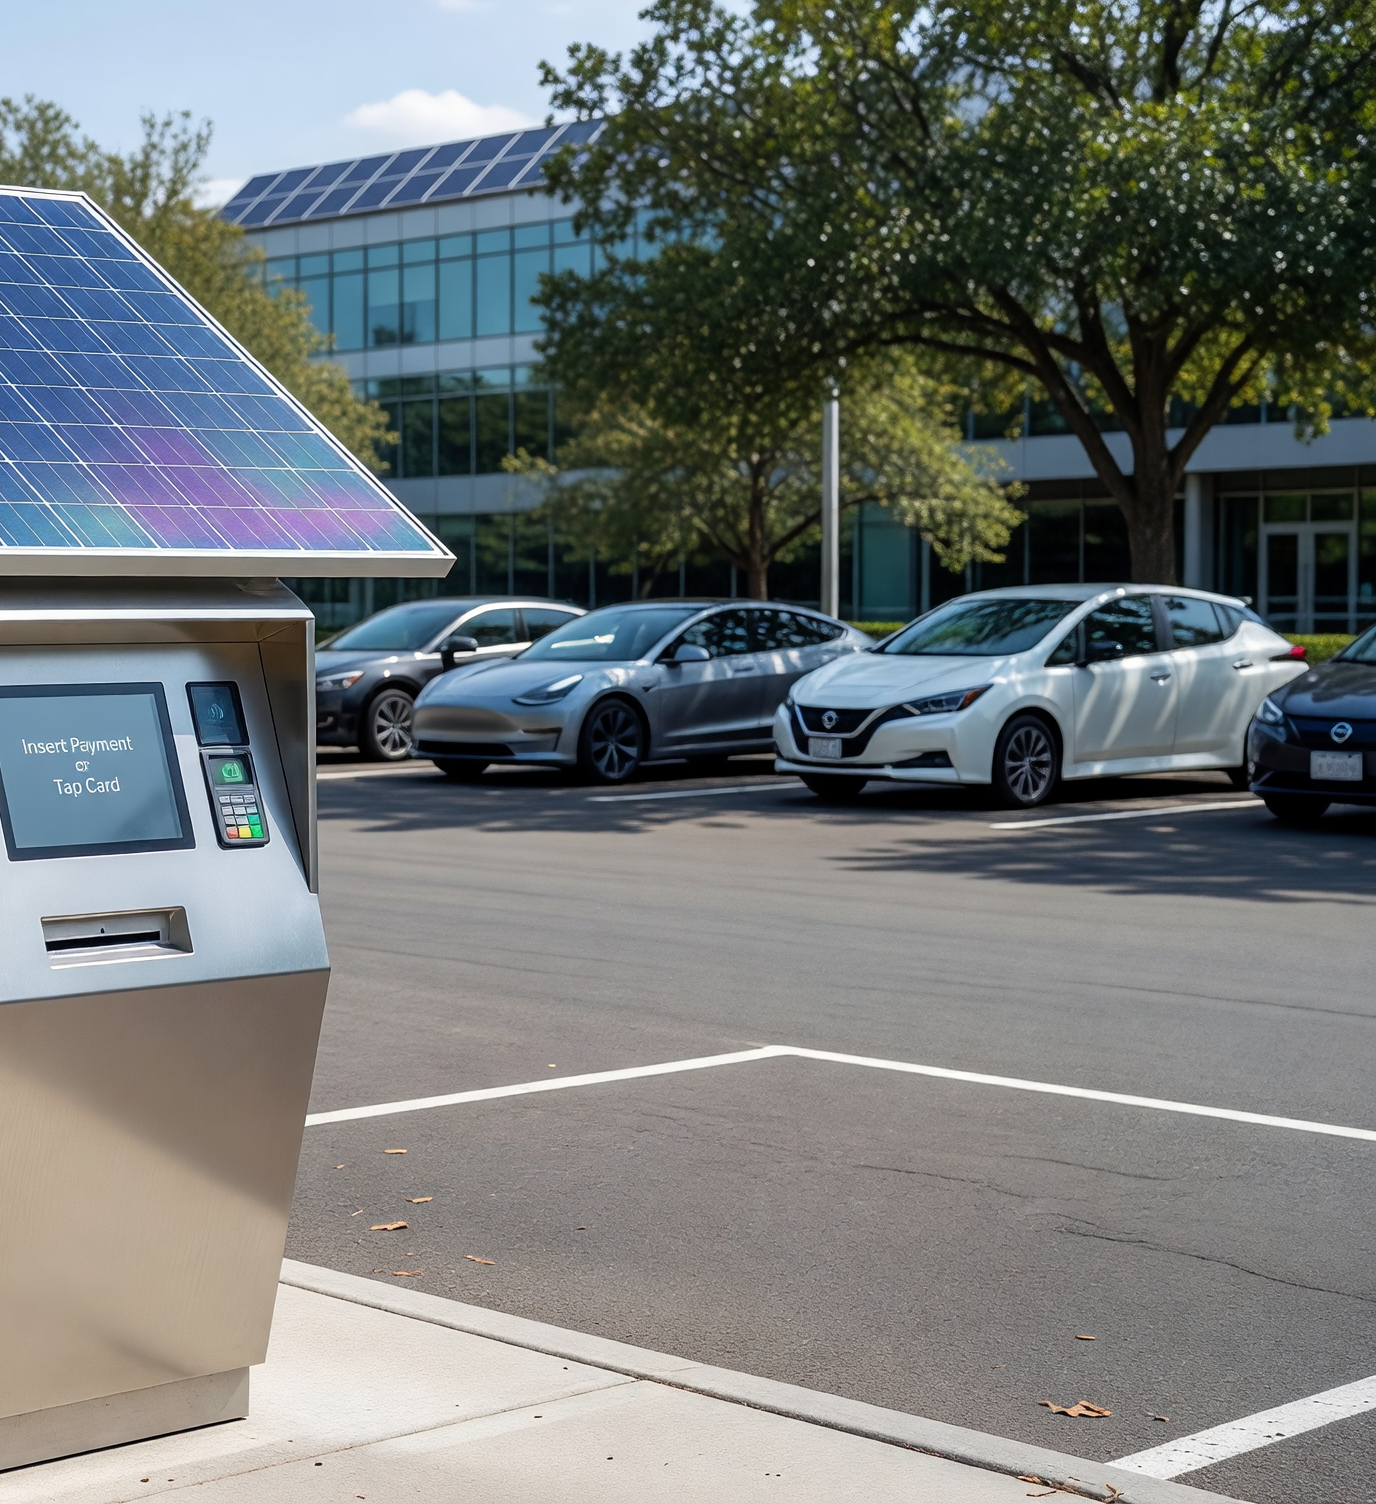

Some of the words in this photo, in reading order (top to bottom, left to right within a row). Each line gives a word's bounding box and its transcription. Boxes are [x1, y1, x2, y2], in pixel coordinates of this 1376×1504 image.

[21, 738, 69, 754] Insert
[70, 736, 134, 756] Payment
[75, 760, 90, 772] or
[53, 778, 83, 798] Tap
[85, 776, 121, 793] Card
